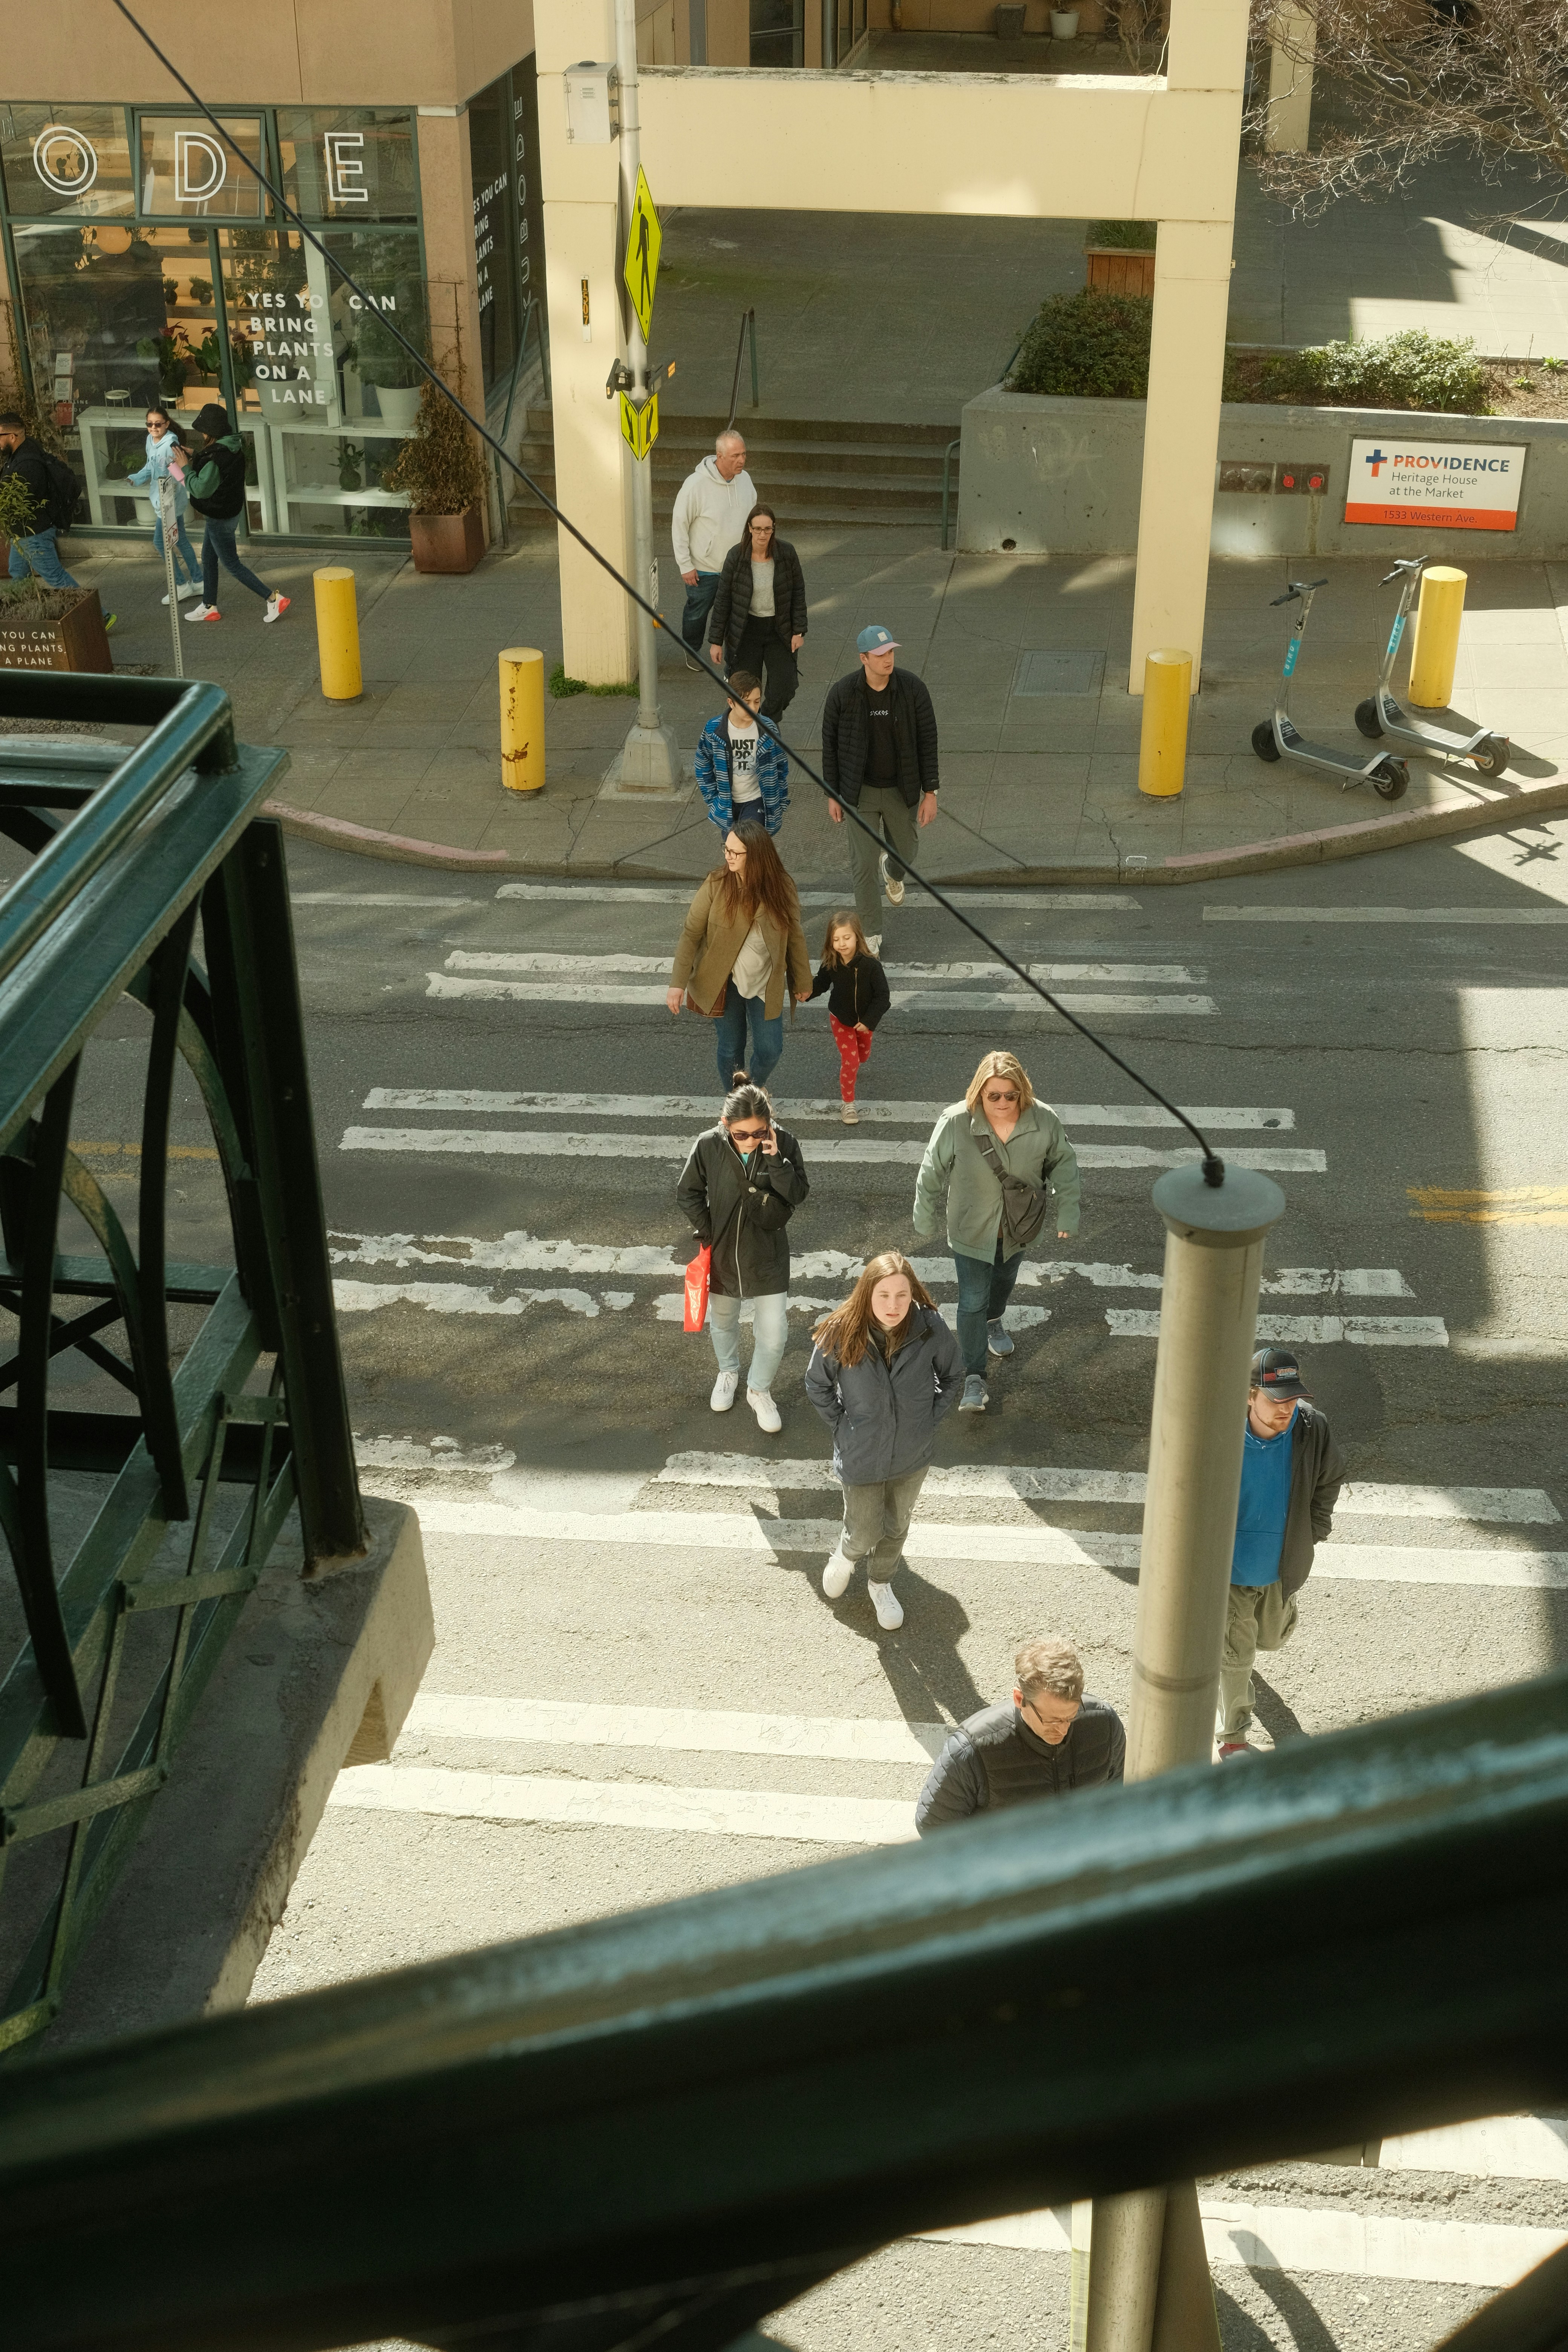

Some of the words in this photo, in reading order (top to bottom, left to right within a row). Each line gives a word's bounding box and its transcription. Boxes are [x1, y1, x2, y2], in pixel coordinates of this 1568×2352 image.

[481, 184, 493, 207] YOU
[495, 172, 507, 194] CAN
[475, 214, 489, 240] RING
[476, 235, 493, 264] LANTS
[478, 271, 482, 288] N
[484, 266, 488, 282] A
[247, 293, 286, 308] YES
[295, 294, 323, 309] YO
[349, 295, 396, 311] CAN
[478, 285, 493, 313] LANE
[250, 317, 318, 333] BRING
[253, 341, 334, 357] PLANTS
[256, 365, 287, 380] ON
[297, 366, 311, 380] A
[271, 389, 326, 404] LANE
[1394, 455, 1510, 472] PROVIDENCE
[1392, 472, 1439, 485] Heritage
[1442, 474, 1478, 485] House
[1389, 487, 1401, 496] at
[1404, 487, 1422, 496] the
[1425, 487, 1464, 499] Market
[1384, 510, 1407, 520] 1533
[1410, 511, 1452, 522] Western
[1455, 513, 1478, 524] Ave.
[1390, 623, 1400, 648] BIRD
[17, 657, 53, 666] PLANE
[1285, 646, 1294, 670] BIRD
[731, 739, 755, 750] JUST
[735, 750, 751, 760] DO
